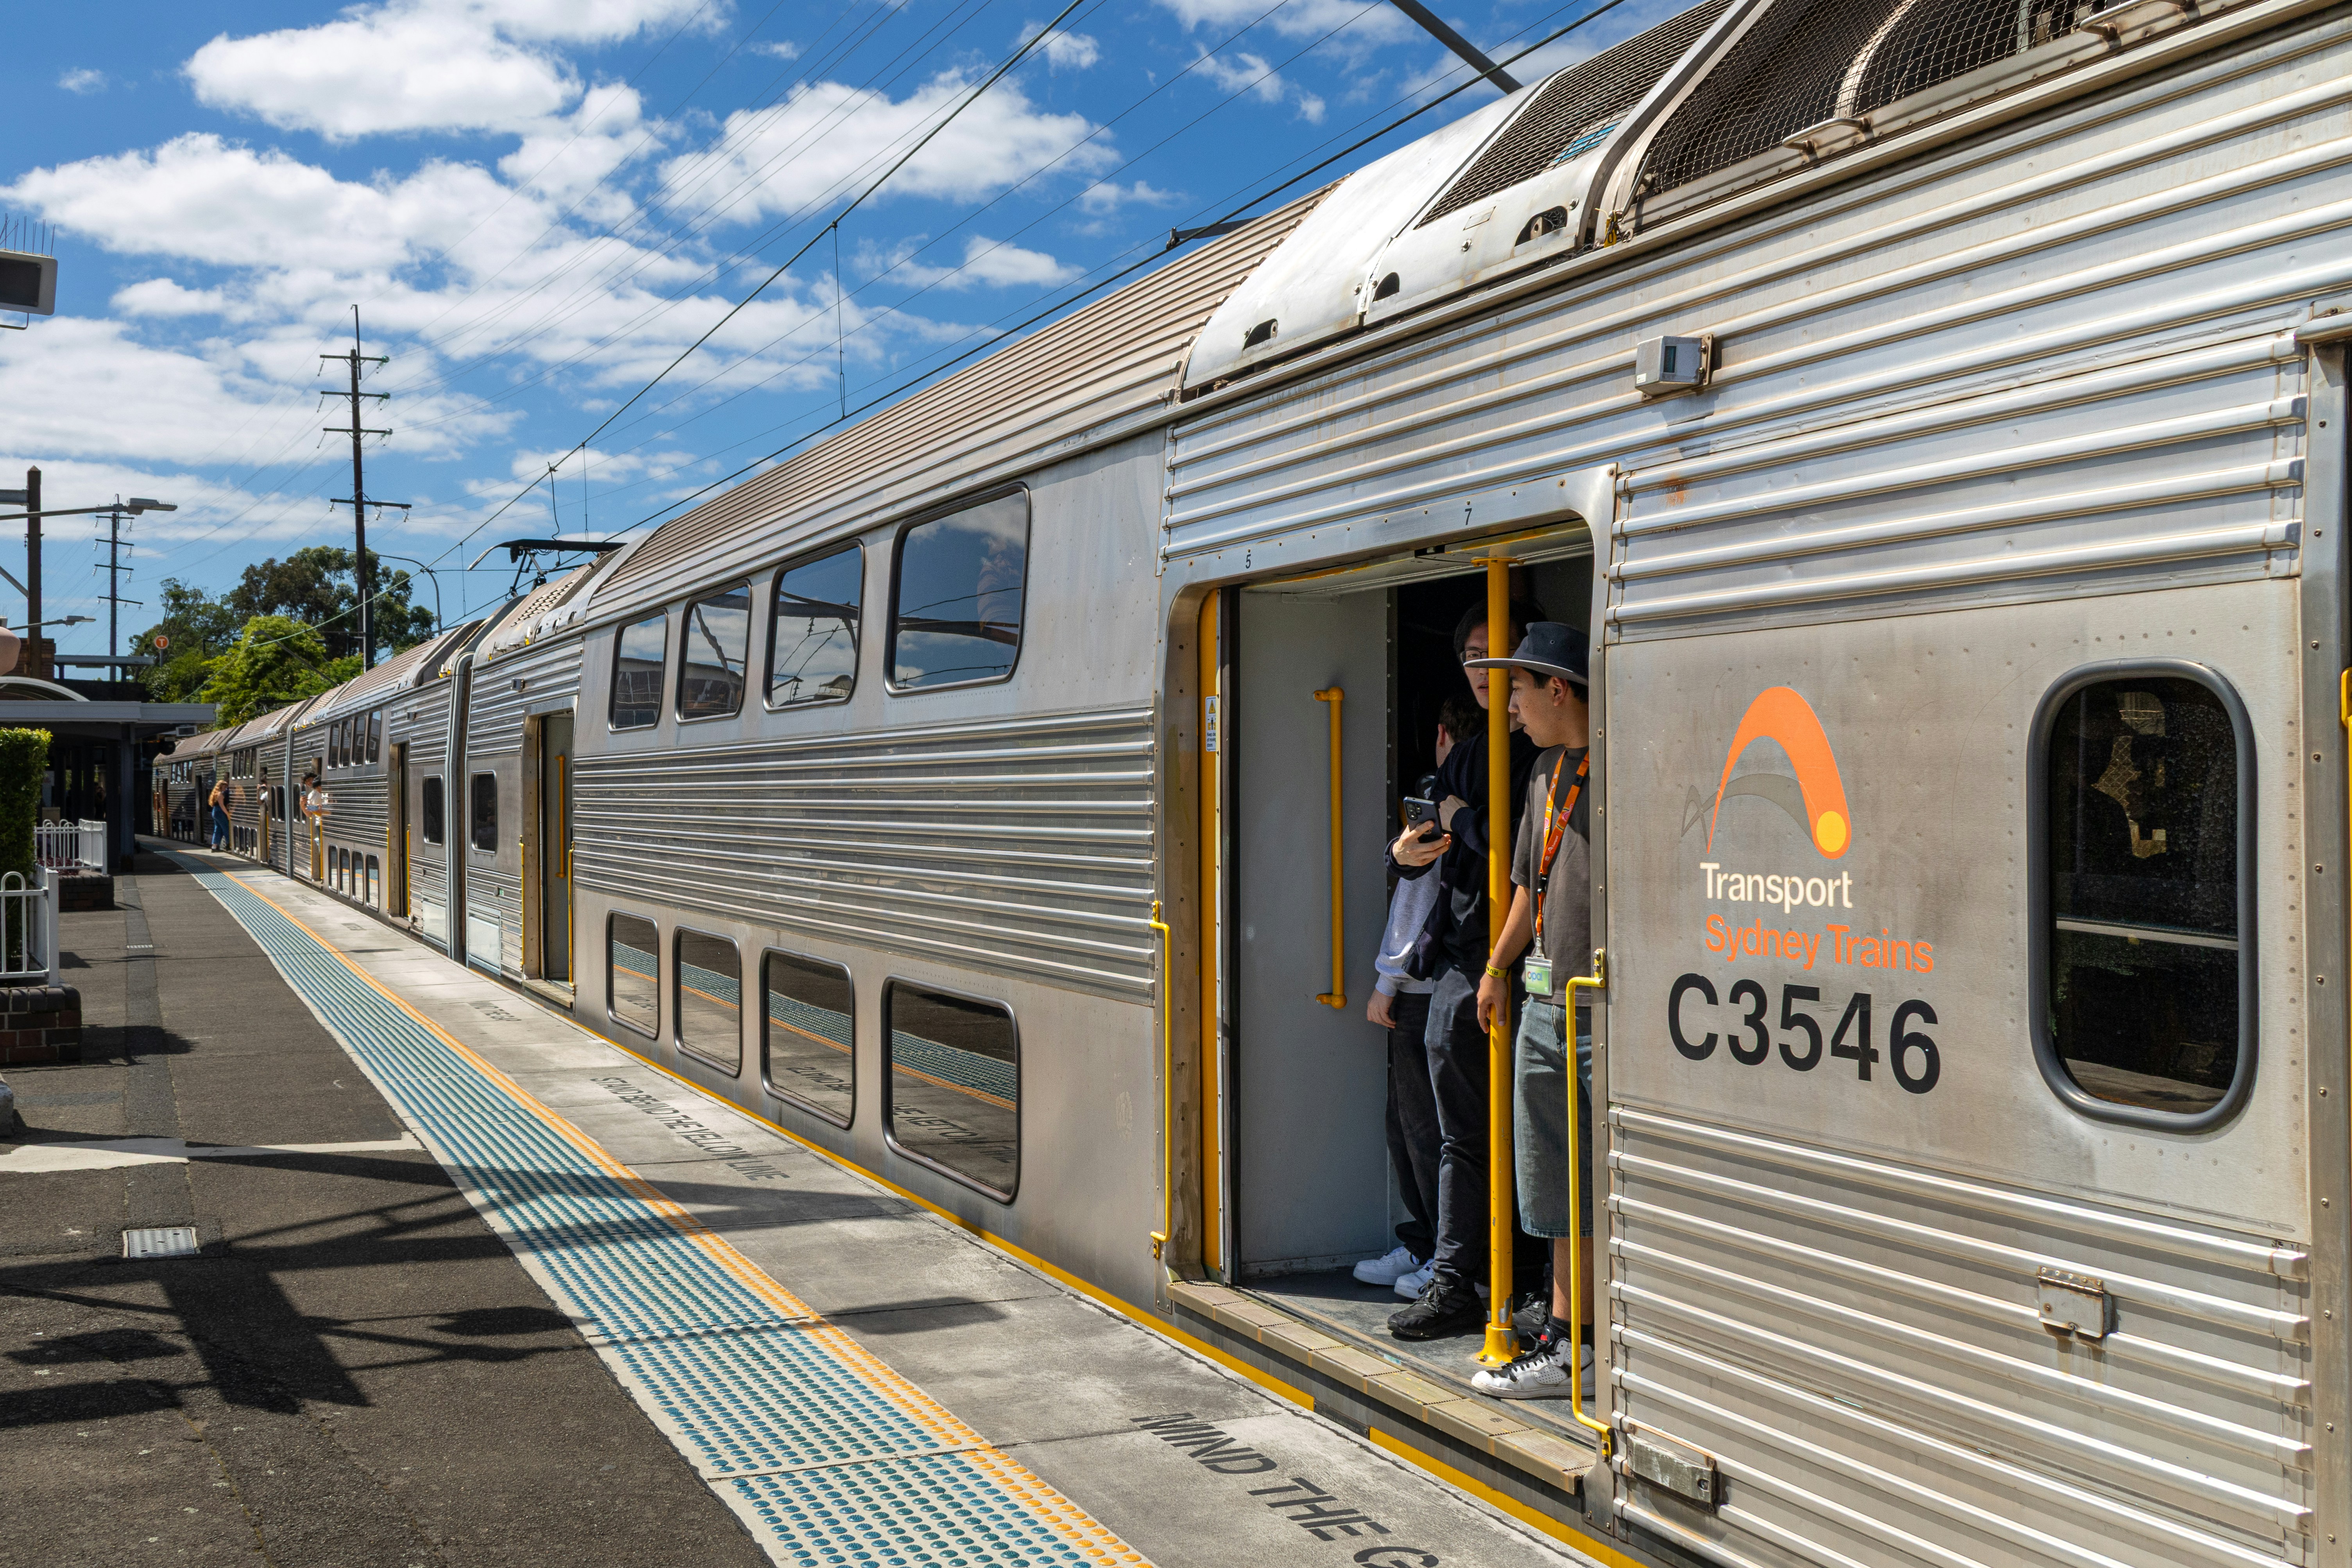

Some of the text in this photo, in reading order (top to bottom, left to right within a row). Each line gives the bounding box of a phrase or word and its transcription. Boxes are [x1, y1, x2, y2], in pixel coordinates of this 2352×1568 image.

[1465, 508, 1472, 525] 7
[1246, 553, 1251, 569] 5
[158, 639, 165, 647] T
[1699, 862, 1853, 914] Transport
[1704, 914, 1934, 974] Sydney Trains
[1668, 972, 1941, 1094] C3546
[590, 1077, 791, 1181] STAND BEHIND THE YELLOW LINE
[1130, 1412, 1278, 1474] MIND
[1247, 1477, 1392, 1541] THE
